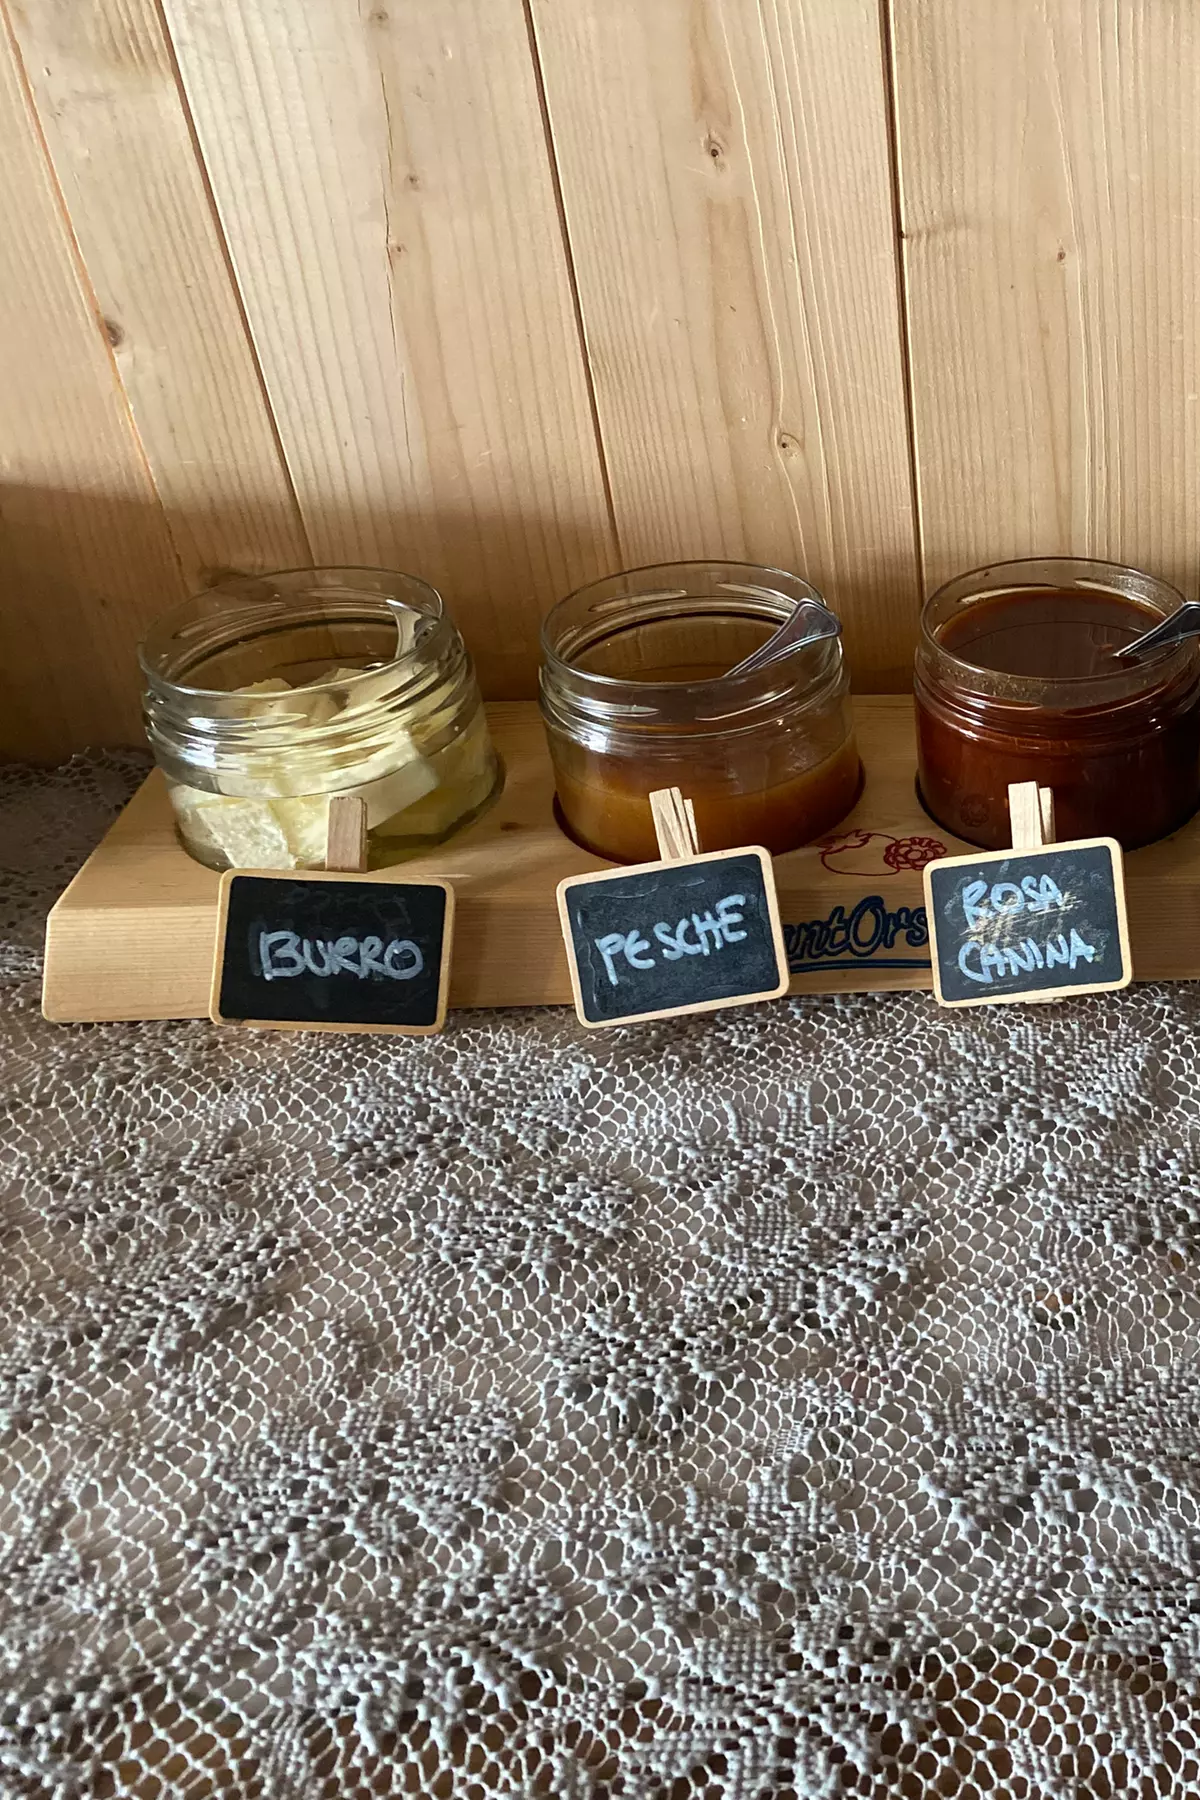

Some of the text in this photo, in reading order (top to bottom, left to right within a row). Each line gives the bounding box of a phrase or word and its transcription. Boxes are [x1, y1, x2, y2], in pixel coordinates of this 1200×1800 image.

[962, 874, 1063, 929] ROSA
[259, 930, 424, 982] BURRO
[595, 894, 748, 986] PESCHE
[958, 928, 1096, 983] CANINA
